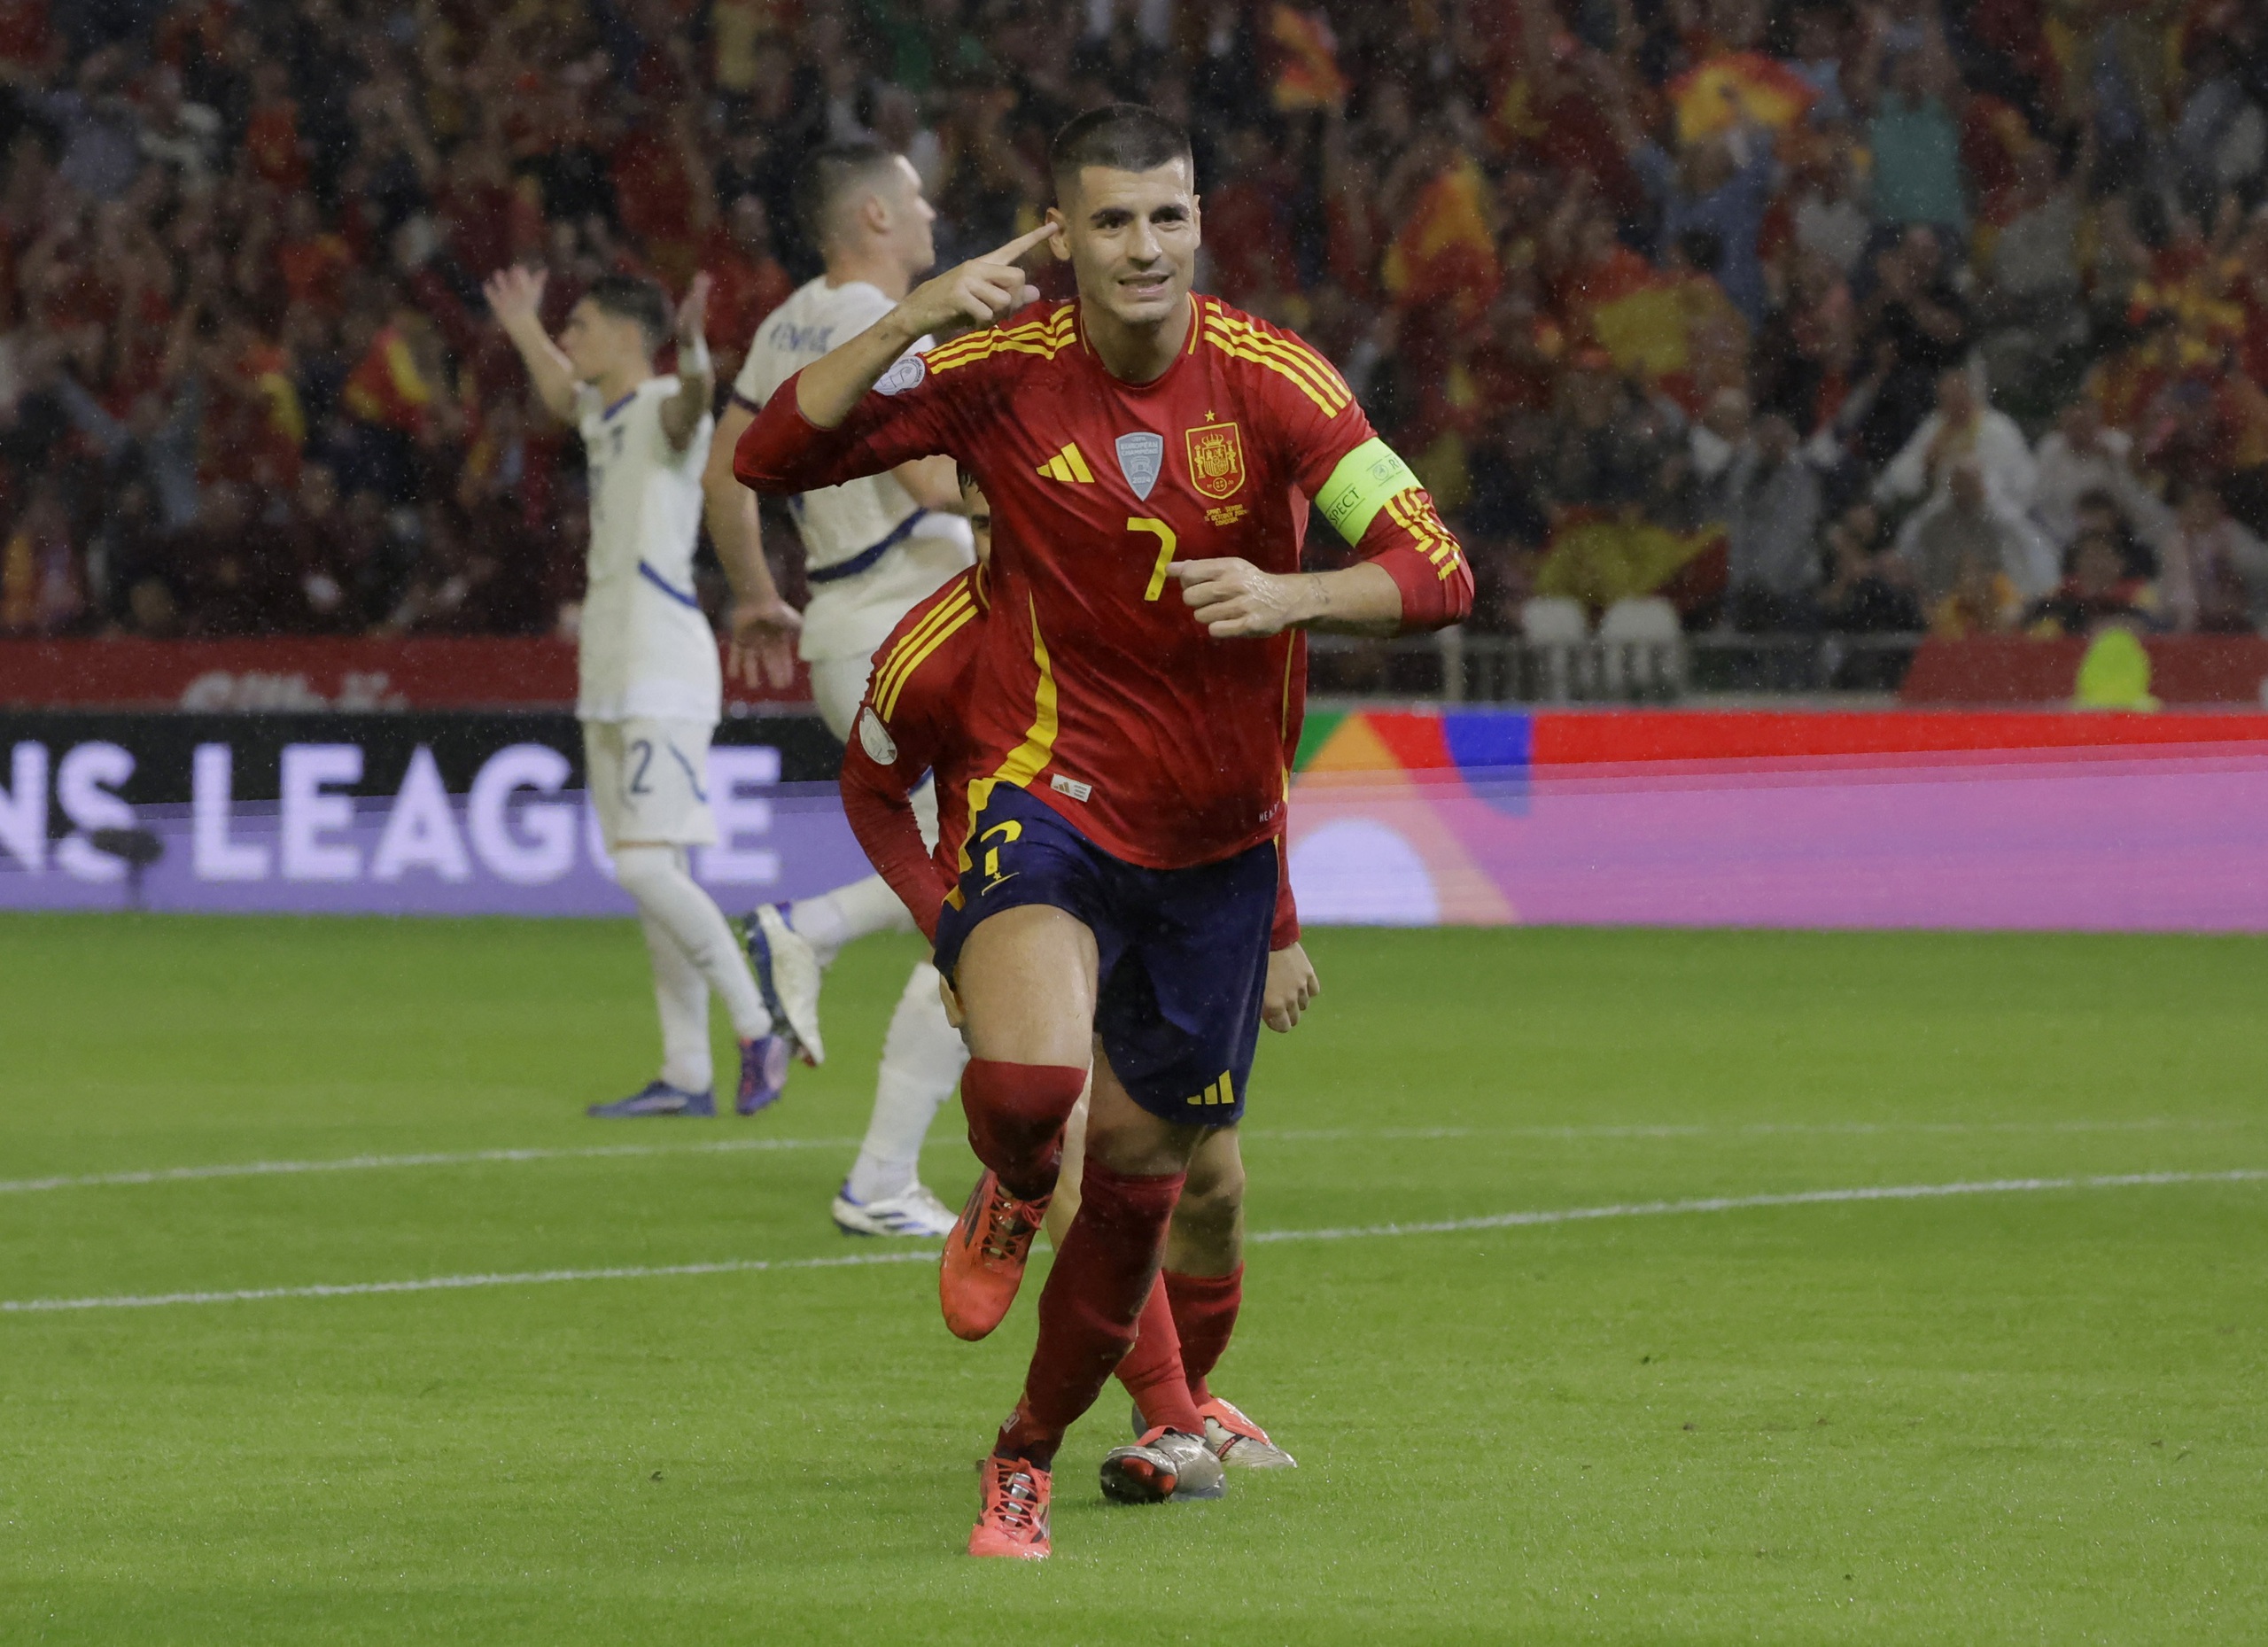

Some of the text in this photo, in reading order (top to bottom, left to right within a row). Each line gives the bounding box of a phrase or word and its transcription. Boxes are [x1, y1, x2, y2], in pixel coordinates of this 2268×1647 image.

[1120, 441, 1158, 450] EUROPEAN
[1127, 517, 1177, 601] 7
[631, 739, 654, 793] 2
[192, 742, 783, 888] LEAGE
[979, 820, 1023, 877] 7
